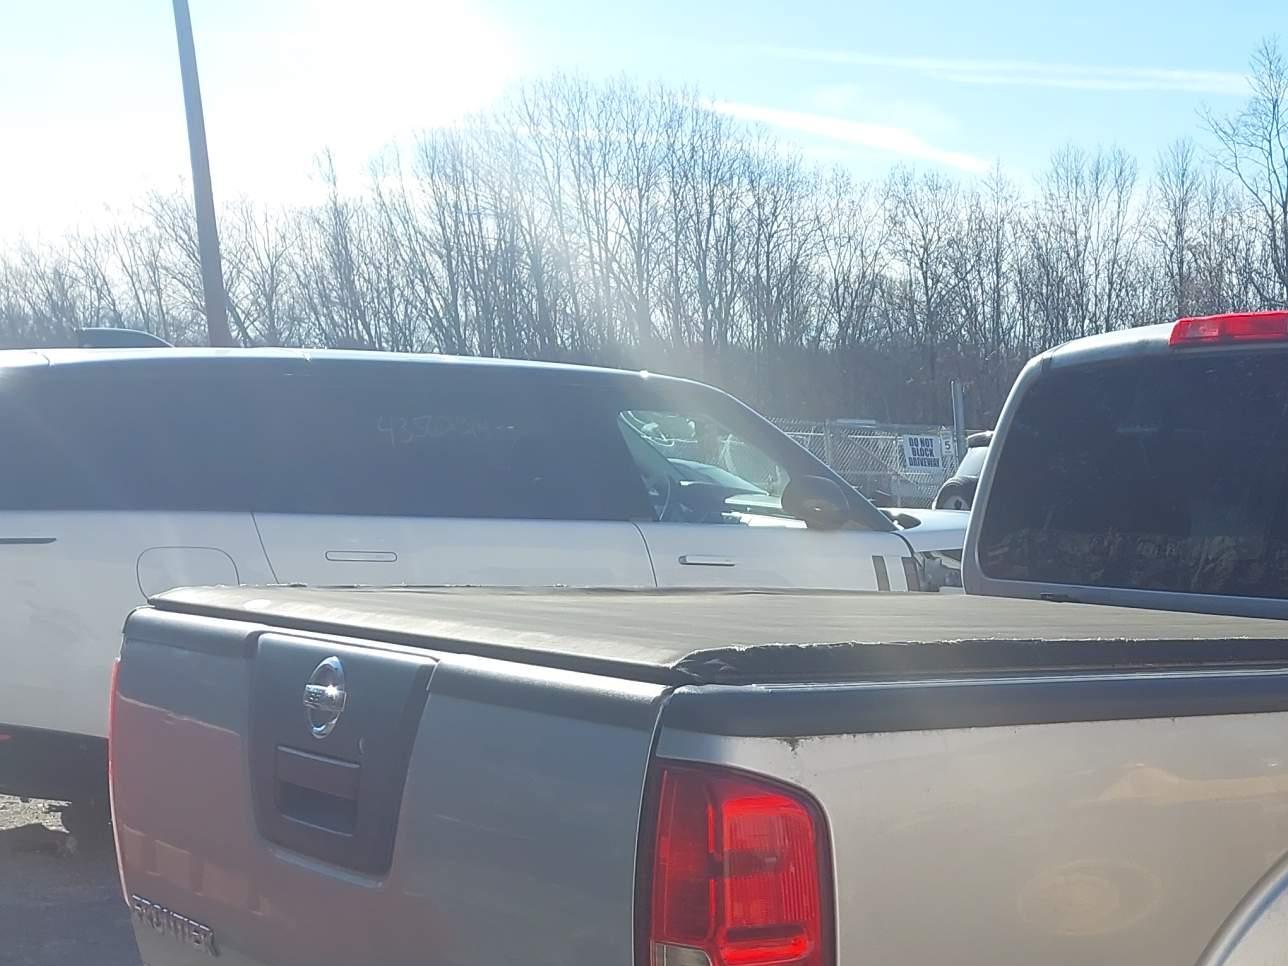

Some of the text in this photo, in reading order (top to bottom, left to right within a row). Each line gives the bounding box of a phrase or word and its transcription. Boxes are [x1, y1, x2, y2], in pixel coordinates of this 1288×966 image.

[908, 437, 934, 448] DO NOT
[944, 440, 951, 450] 5
[911, 447, 935, 457] BLOCK
[908, 457, 940, 467] DRIVEWAY
